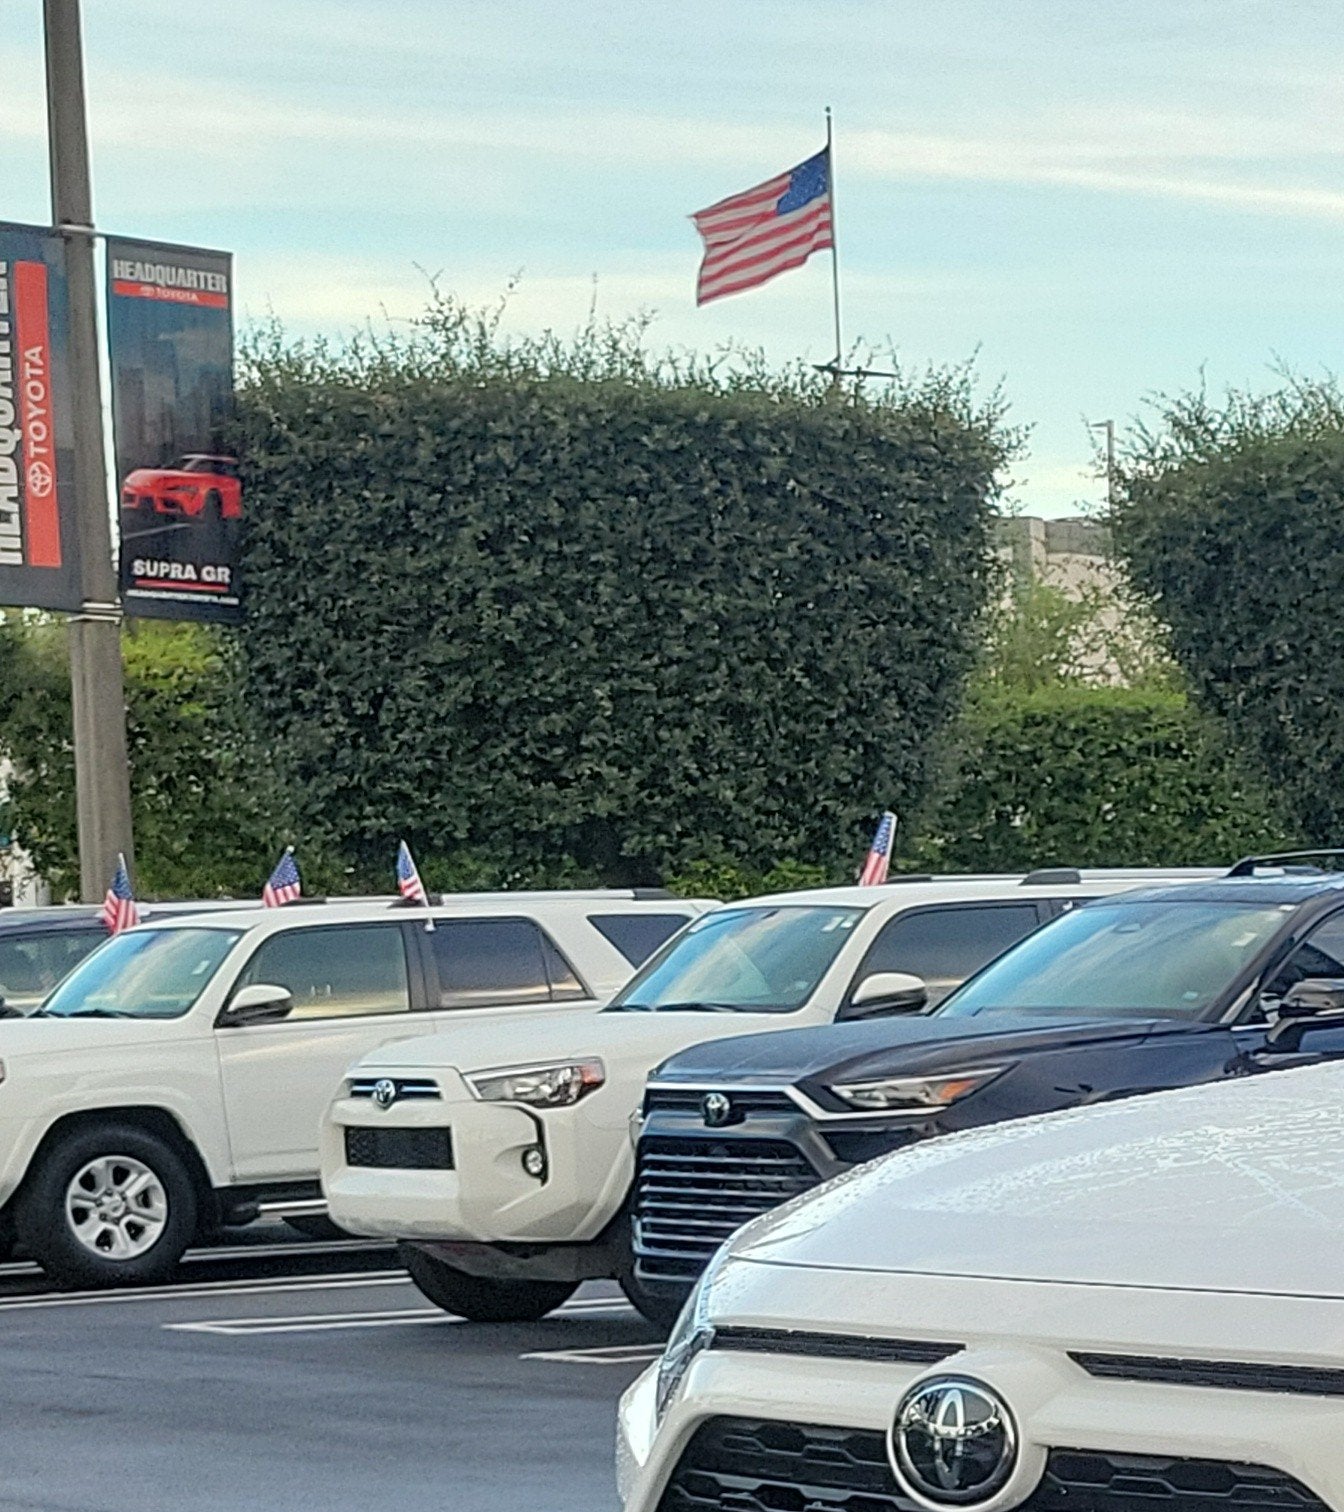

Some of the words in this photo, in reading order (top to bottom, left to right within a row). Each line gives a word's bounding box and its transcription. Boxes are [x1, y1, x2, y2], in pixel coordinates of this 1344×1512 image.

[113, 259, 227, 293] HEADQUARTER
[156, 286, 200, 303] TOYOTA
[24, 346, 48, 458] TOYOTA
[132, 559, 198, 581] SUPRA
[201, 565, 231, 584] GR
